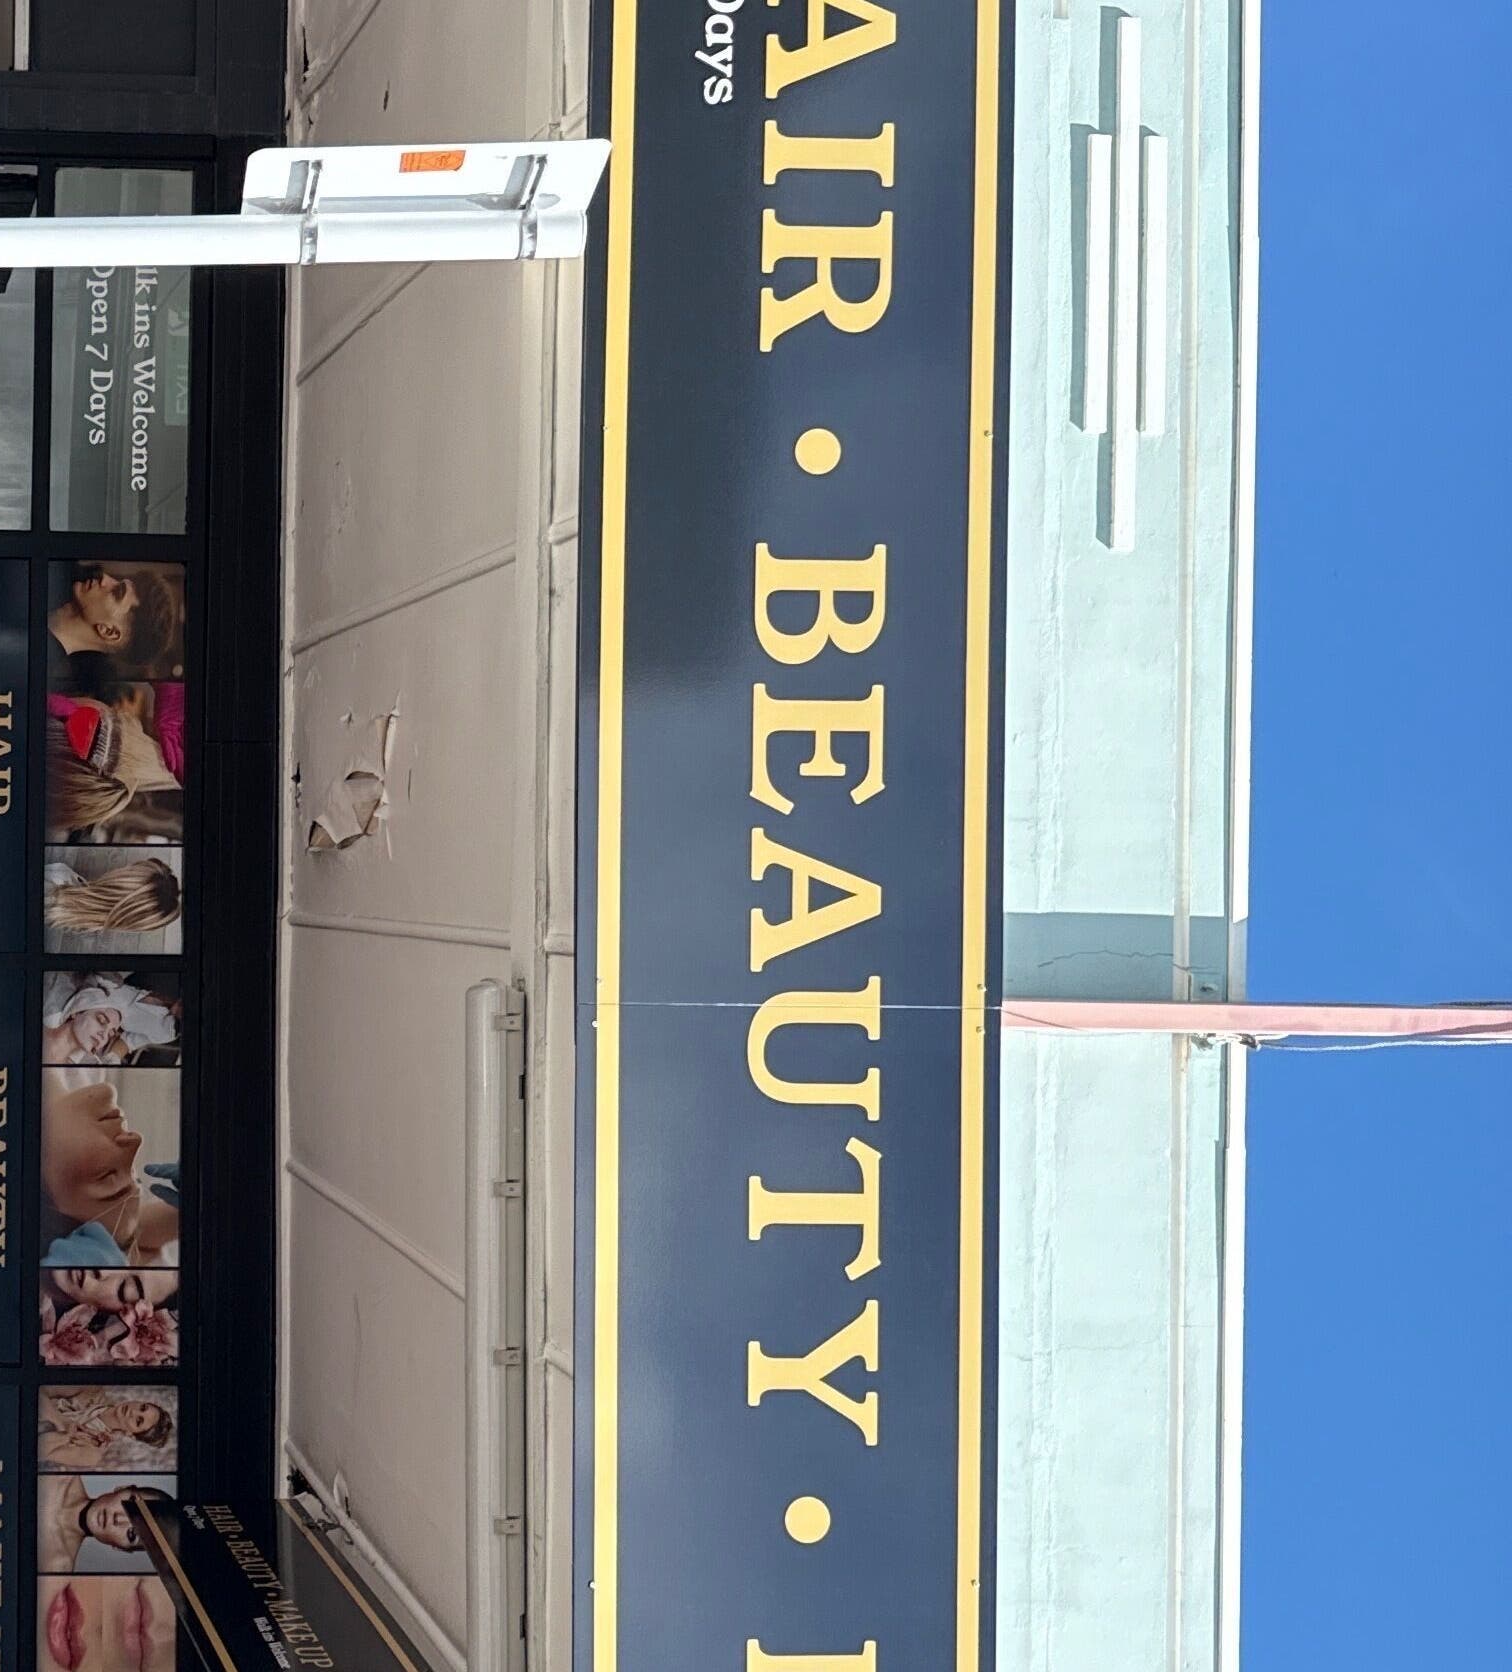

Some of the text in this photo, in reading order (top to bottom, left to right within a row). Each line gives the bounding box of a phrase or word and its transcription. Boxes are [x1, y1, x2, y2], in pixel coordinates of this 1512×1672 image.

[83, 343, 109, 361] 7
[83, 369, 113, 445] Days
[130, 267, 156, 491] lk ins Welcome
[746, 542, 888, 1446] BEAUTY
[203, 1505, 333, 1668] HAIR BEAUTY MAKE UP
[270, 1642, 290, 1669] Welcome
